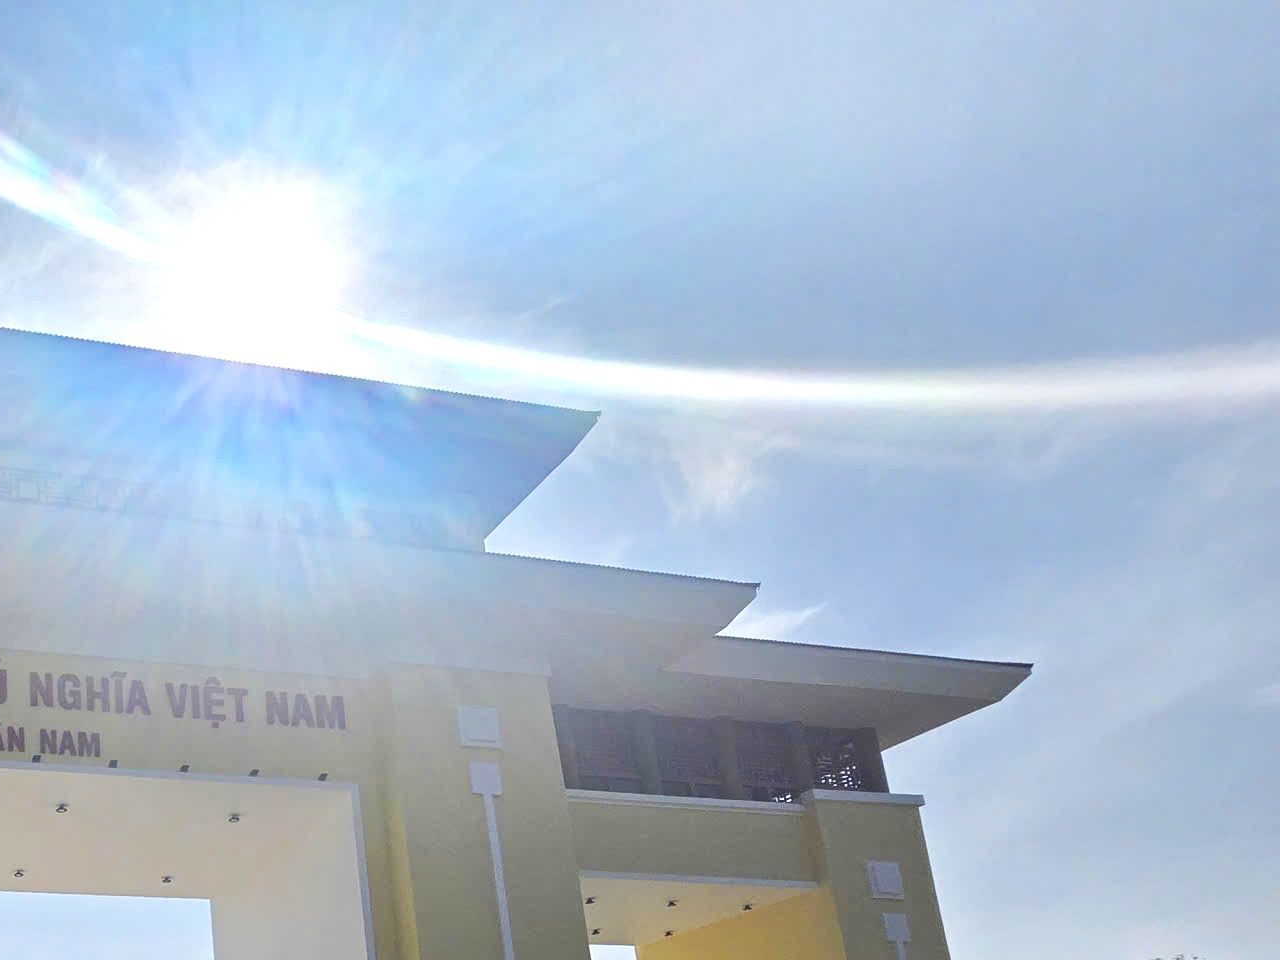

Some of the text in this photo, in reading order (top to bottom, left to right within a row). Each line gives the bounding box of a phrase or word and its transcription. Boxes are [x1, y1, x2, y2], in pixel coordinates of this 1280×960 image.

[30, 670, 151, 717] NGHĨA
[165, 676, 248, 729] VIỆT
[265, 690, 347, 730] NAM
[39, 728, 101, 758] NAM
